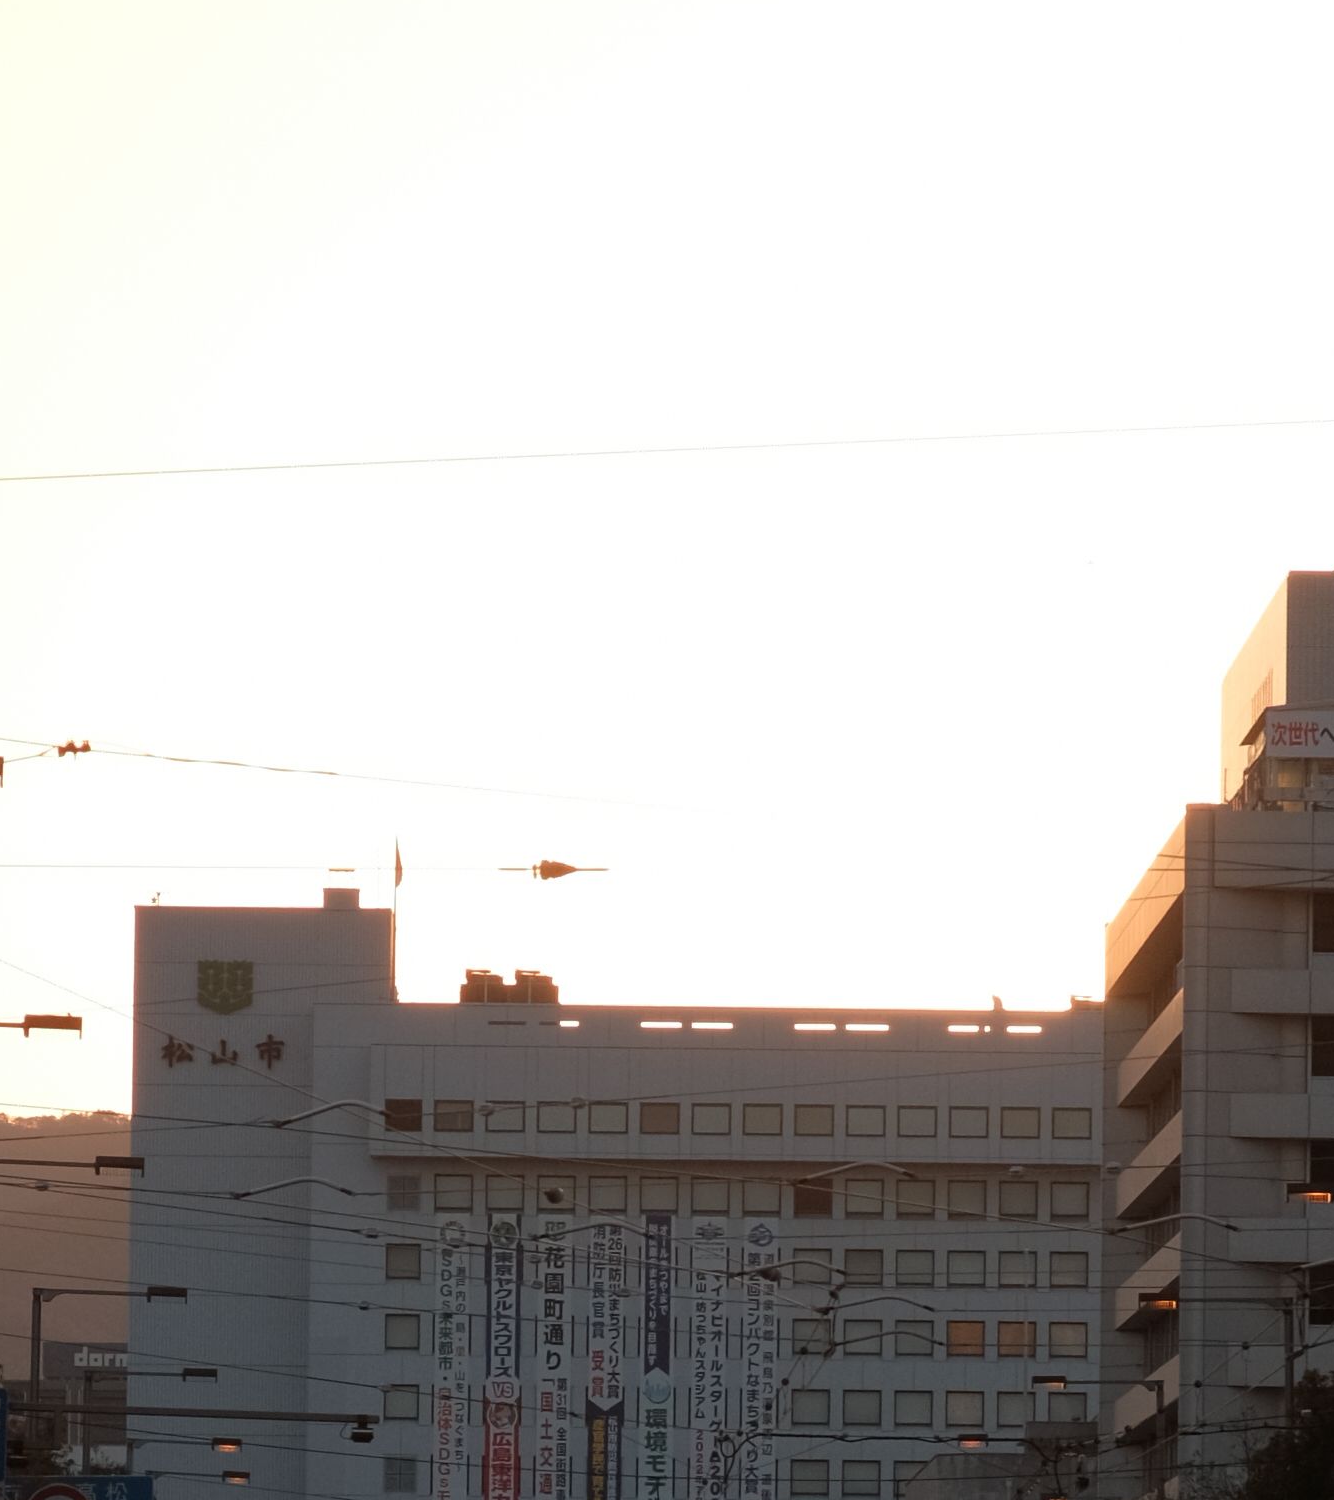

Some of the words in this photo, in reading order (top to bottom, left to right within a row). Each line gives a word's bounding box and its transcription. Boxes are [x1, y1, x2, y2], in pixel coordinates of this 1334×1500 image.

[161, 1035, 285, 1068] 松山市
[494, 1251, 514, 1379] 東京ヤクルトスワローズ
[543, 1248, 565, 1370] 花園町通り
[491, 1381, 515, 1399] VS
[591, 1350, 605, 1398] 受賞
